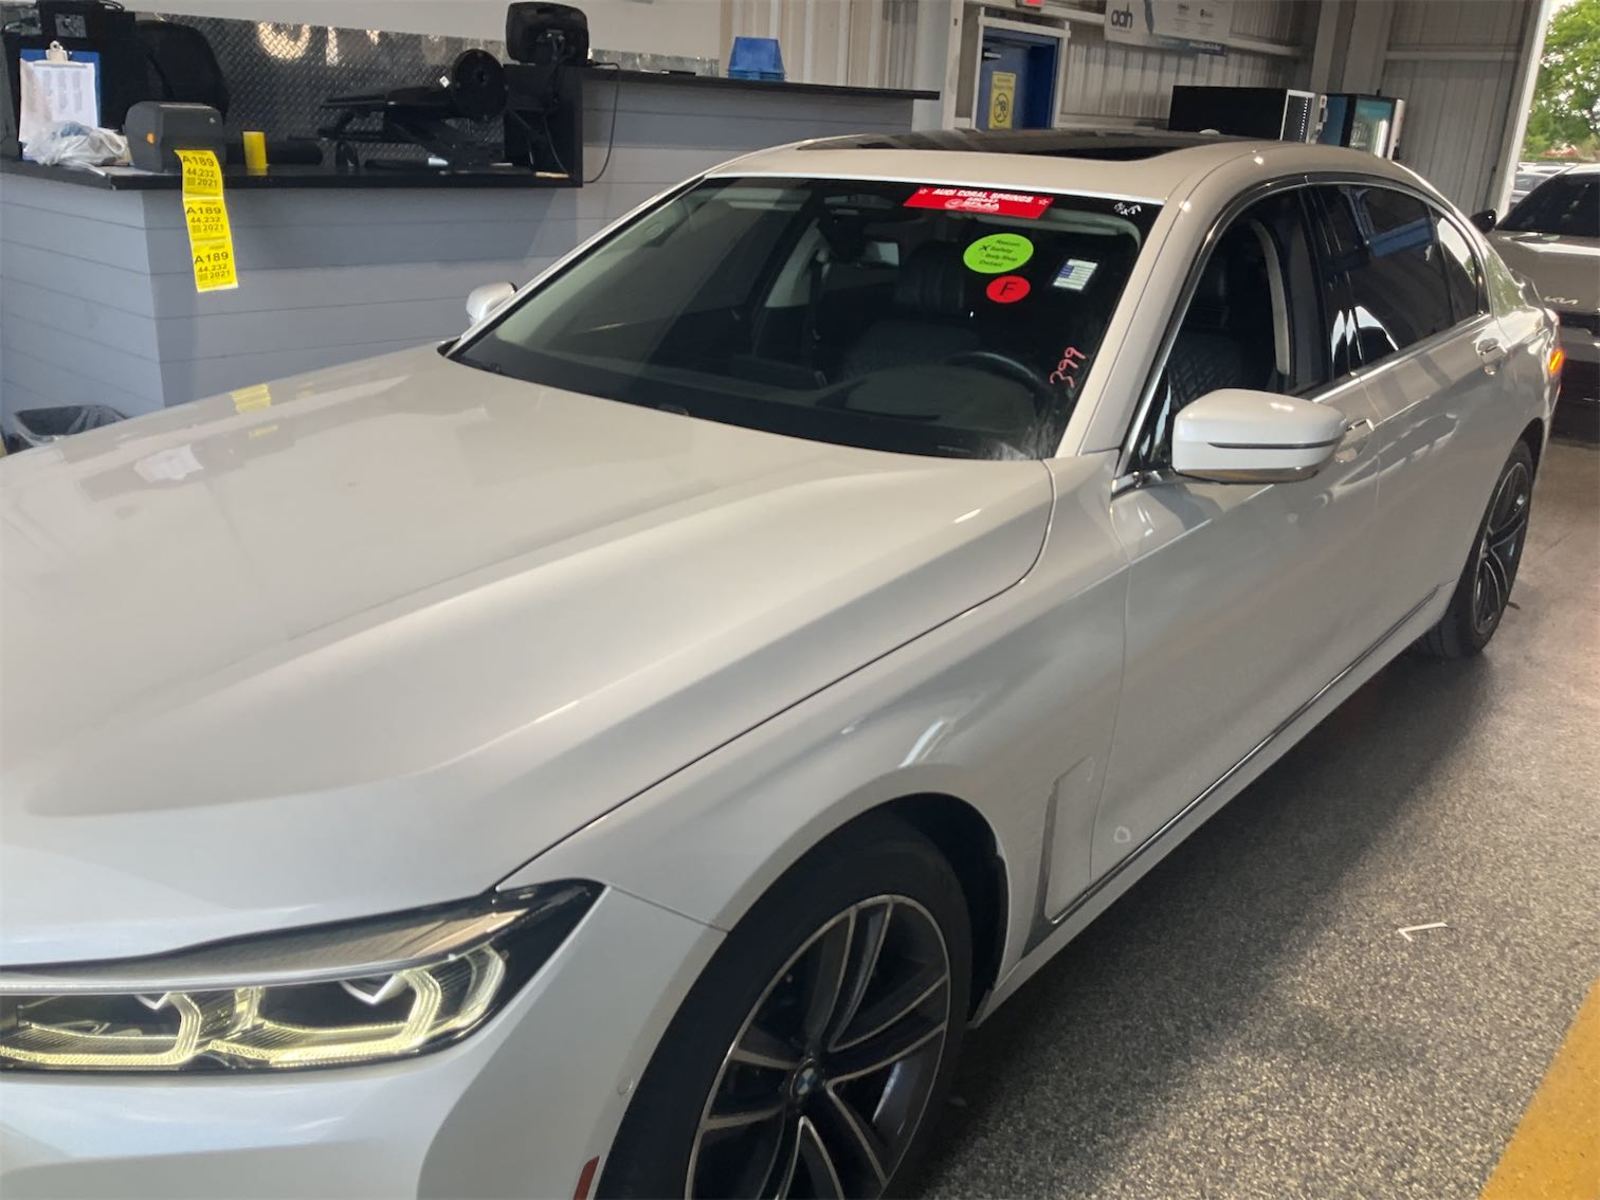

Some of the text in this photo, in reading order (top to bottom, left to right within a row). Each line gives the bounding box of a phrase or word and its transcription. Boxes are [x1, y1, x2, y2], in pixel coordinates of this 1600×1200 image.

[183, 156, 214, 167] A189
[197, 178, 218, 187] 2021
[932, 188, 956, 196] AUDI
[957, 190, 987, 198] CORAL
[989, 192, 1034, 203] SPRINGS
[187, 206, 221, 214] A189
[203, 224, 224, 232] 2021
[194, 251, 229, 264] A189
[210, 270, 230, 279] 2021
[999, 281, 1017, 297] F
[1050, 346, 1087, 389] 399
